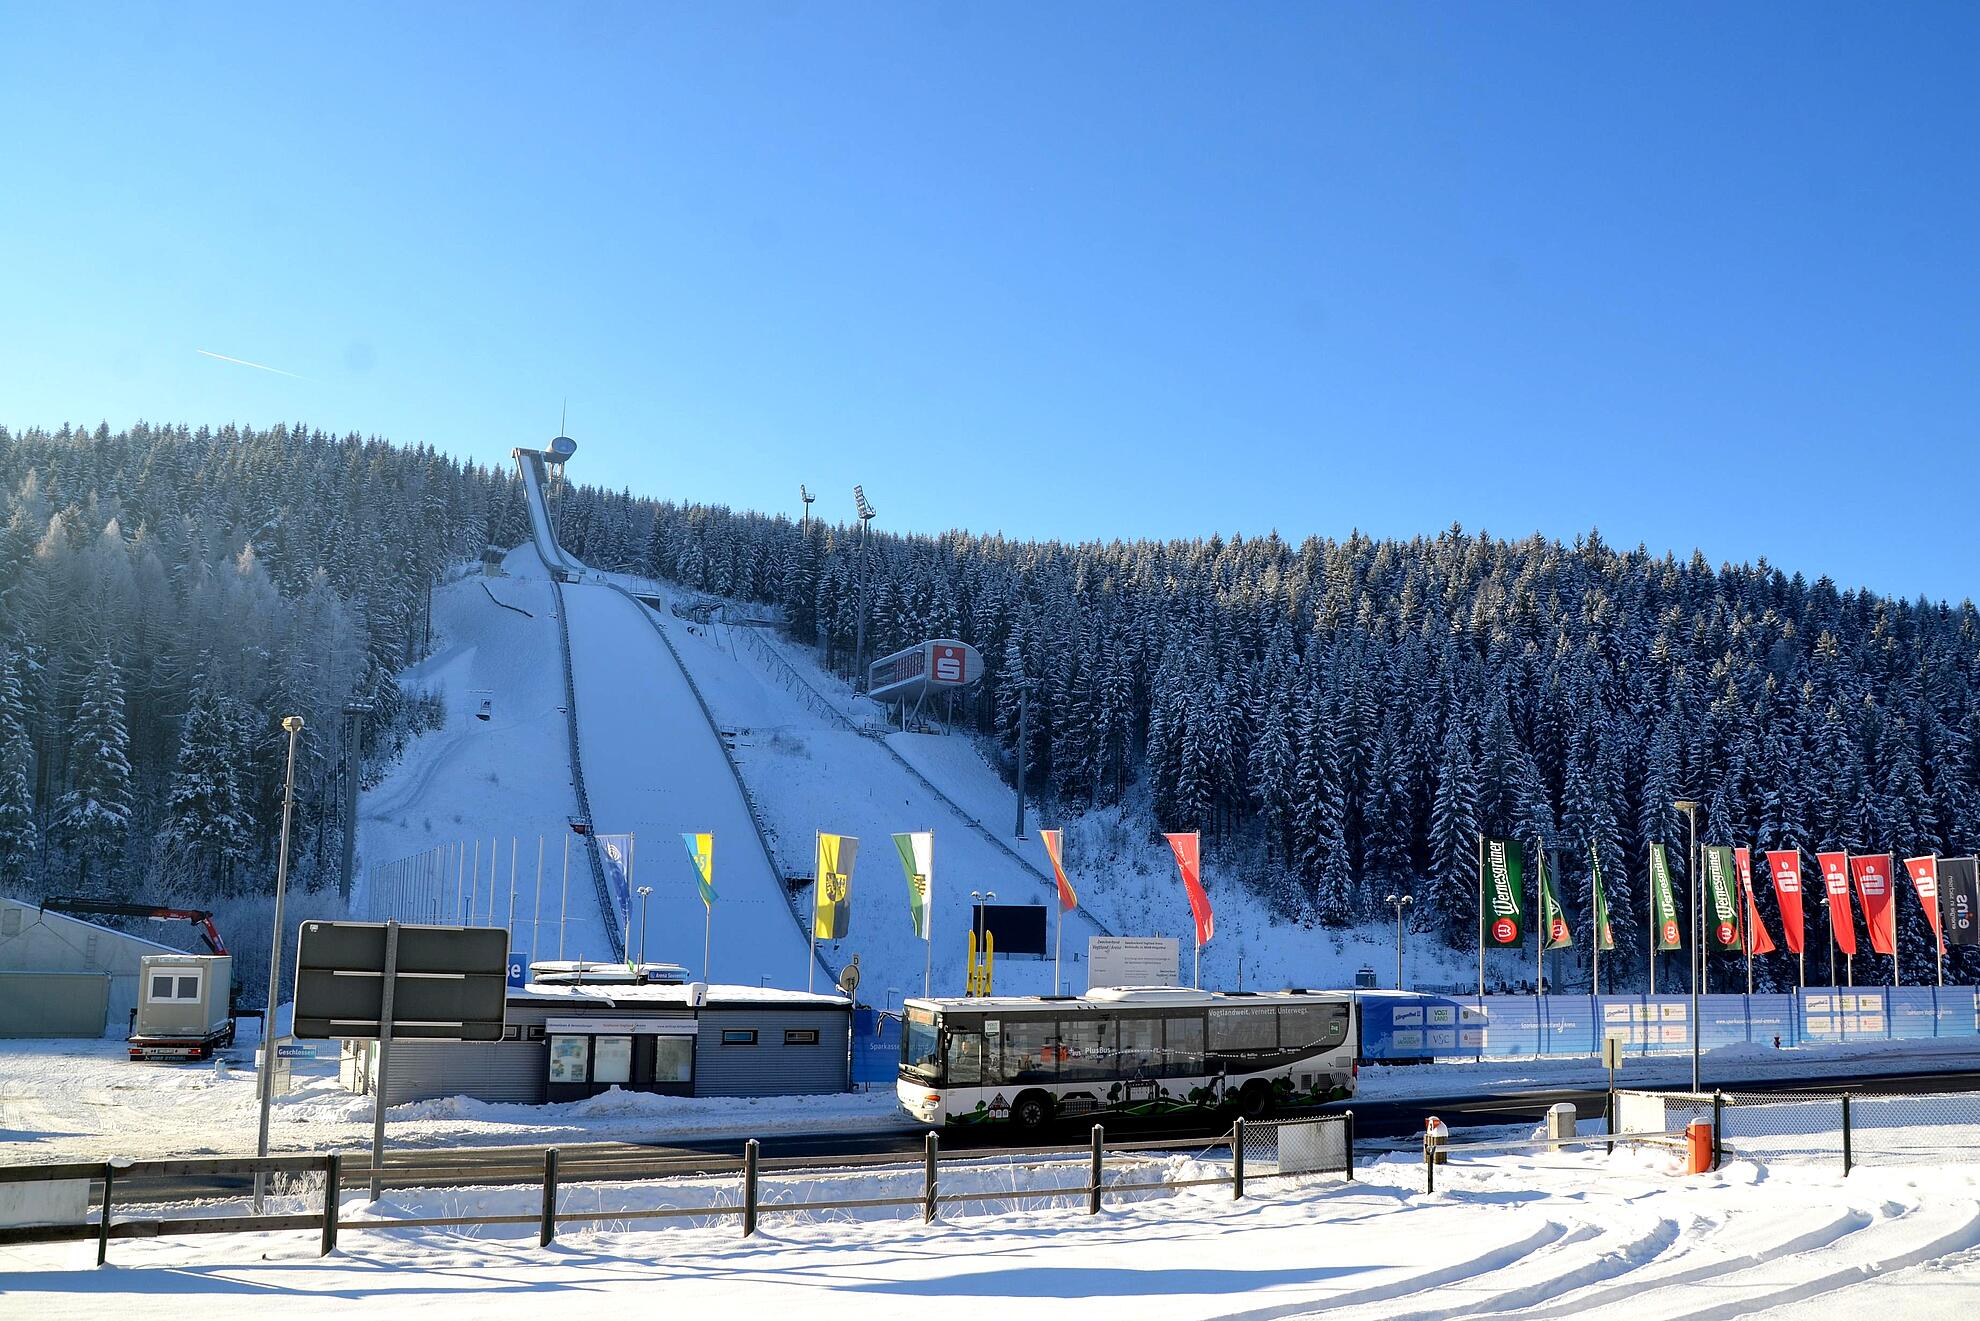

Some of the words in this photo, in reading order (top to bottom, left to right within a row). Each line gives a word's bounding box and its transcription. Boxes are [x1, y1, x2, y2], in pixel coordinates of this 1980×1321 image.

[1488, 841, 1518, 916] Wernesgrüner
[1708, 850, 1734, 920] Wernesgrüner
[1208, 1008, 1251, 1017] Vogtlandweit.
[1251, 1008, 1277, 1016] Vernetzt.
[1277, 1007, 1309, 1016] Unterwegs.
[278, 1048, 315, 1056] Geschlossen
